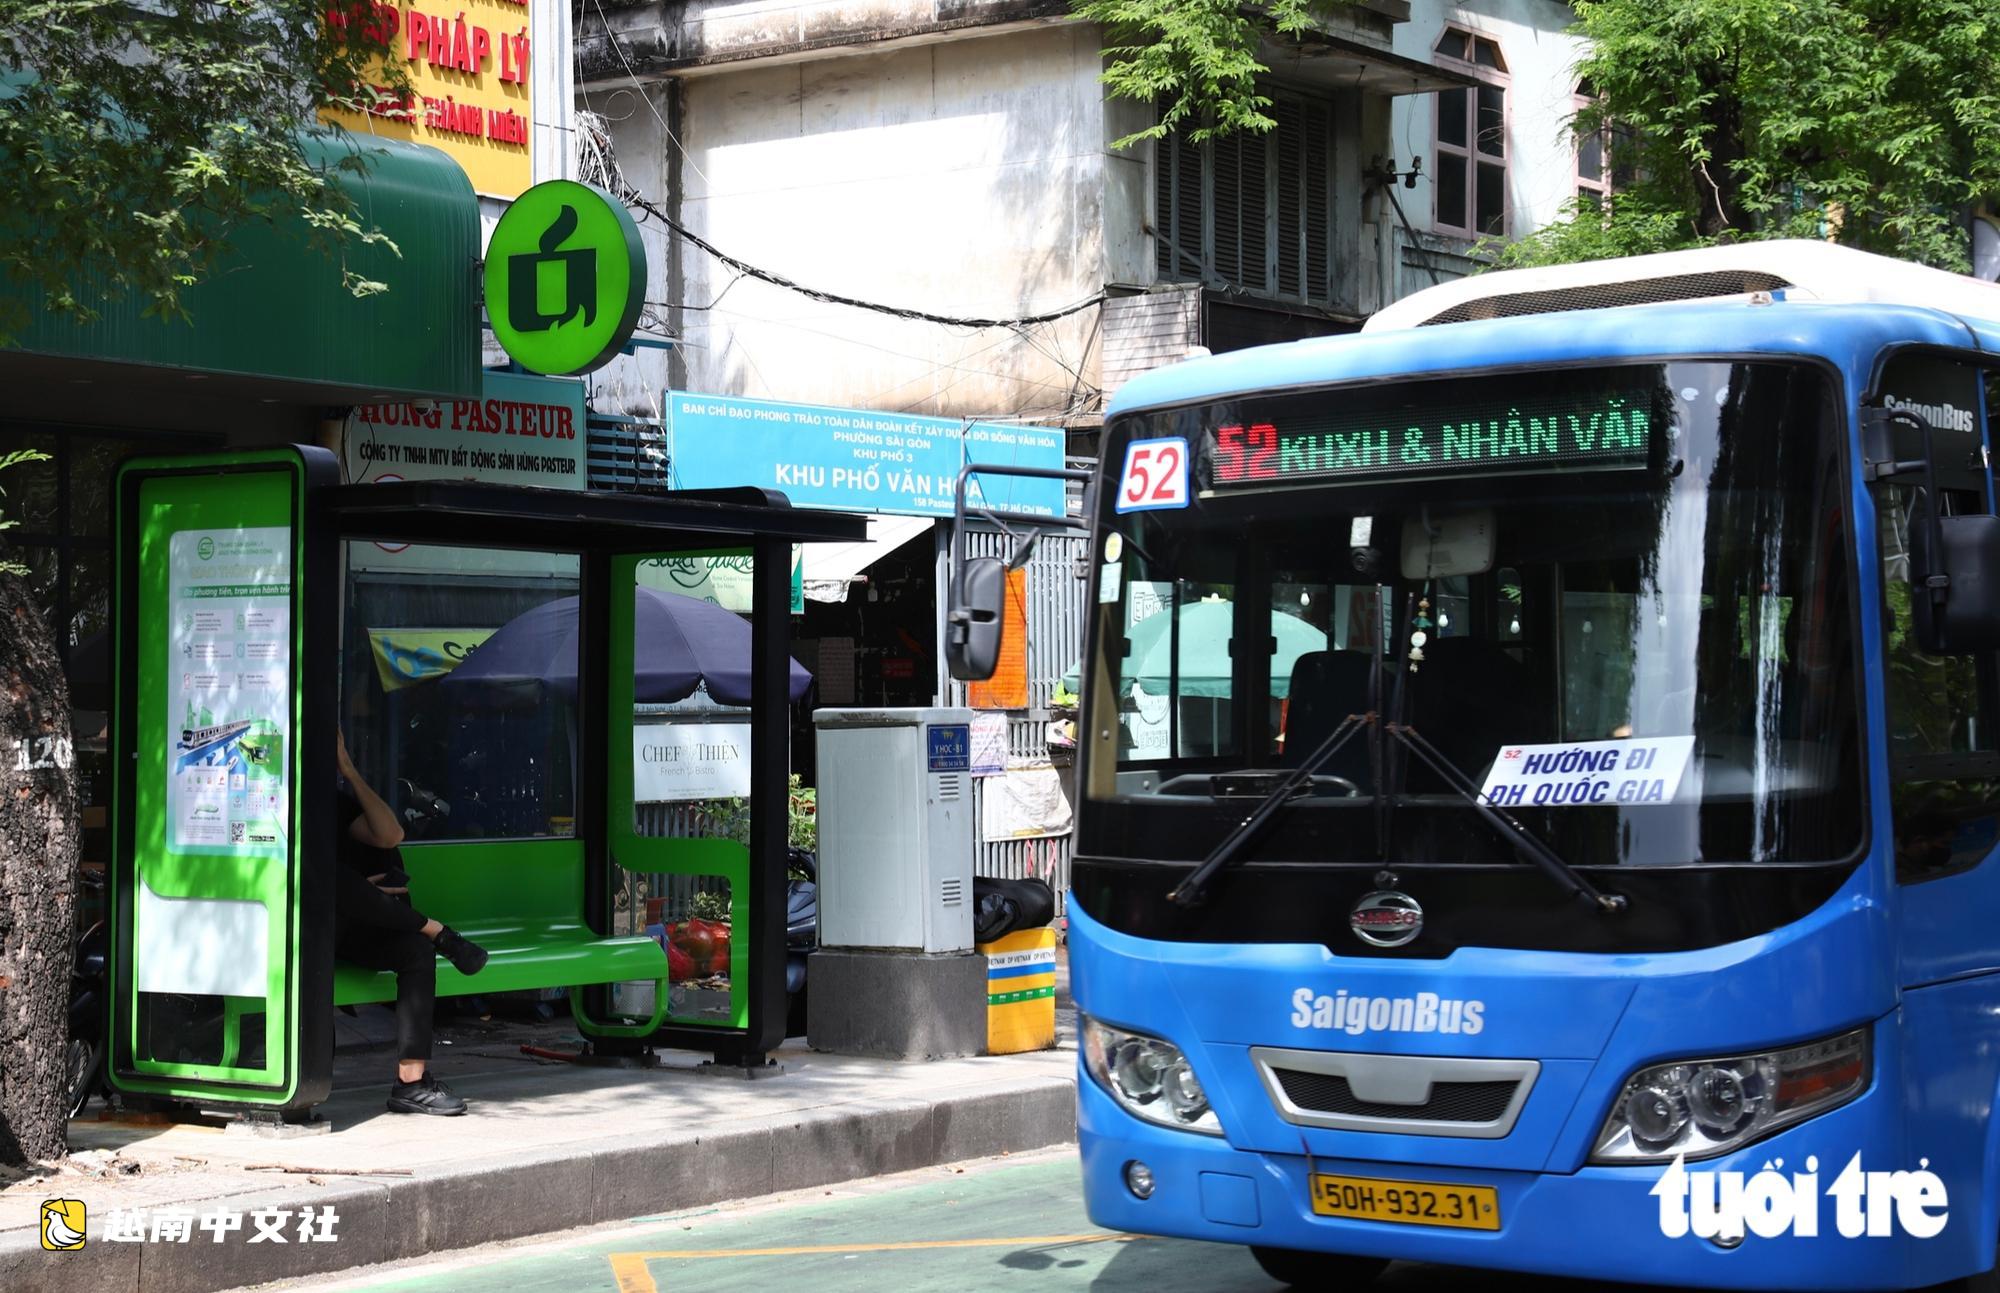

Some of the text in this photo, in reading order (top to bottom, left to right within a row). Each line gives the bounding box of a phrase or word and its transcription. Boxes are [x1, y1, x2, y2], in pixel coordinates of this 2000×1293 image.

[408, 12, 490, 74] PHÁP
[499, 26, 530, 84] LÝ
[451, 399, 575, 440] PASTEUR
[682, 403, 705, 414] BAN
[708, 402, 726, 416] CHỈ
[729, 407, 752, 420] ĐẠO
[754, 411, 790, 423] PHONG
[793, 411, 821, 425] TRÀO
[824, 415, 850, 428] TOÀN
[852, 417, 873, 430] DÂN
[876, 419, 902, 432] ĐOÀN
[904, 421, 923, 434] KẾT
[924, 424, 943, 436] XÂY
[991, 428, 1016, 444] SỐNG
[1017, 432, 1035, 446] VĂN
[1037, 433, 1056, 448] HÓA
[833, 430, 931, 449] PHƯỜNG SÀI GÒN
[853, 448, 913, 462] KHU PHỐ 3
[1217, 422, 1278, 481] 52
[1281, 429, 1389, 472] KHXH
[1401, 427, 1431, 462] &
[1443, 408, 1557, 461] NHÂN
[360, 440, 386, 461] CÔNG
[388, 447, 401, 462] TY
[404, 447, 427, 464] TNHH
[429, 448, 449, 465] MTV
[452, 444, 468, 466] BẤT
[471, 450, 496, 472] ĐỘNG
[541, 456, 576, 474] PASTEUR
[775, 463, 825, 487] KHU
[832, 462, 880, 491] PHỐ
[886, 468, 931, 496] VĂN
[1127, 446, 1177, 503] 52
[642, 739, 740, 765] CHEF THIỆN
[1504, 749, 1522, 759] 52
[1521, 747, 1657, 775] HƯỚNG ĐI
[660, 766, 715, 777] French Bistro
[1487, 784, 1527, 806] ĐH
[1616, 779, 1664, 803] GIA
[1291, 987, 1485, 1036] SaigonBus
[1324, 1183, 1479, 1221] 50H-932.31
